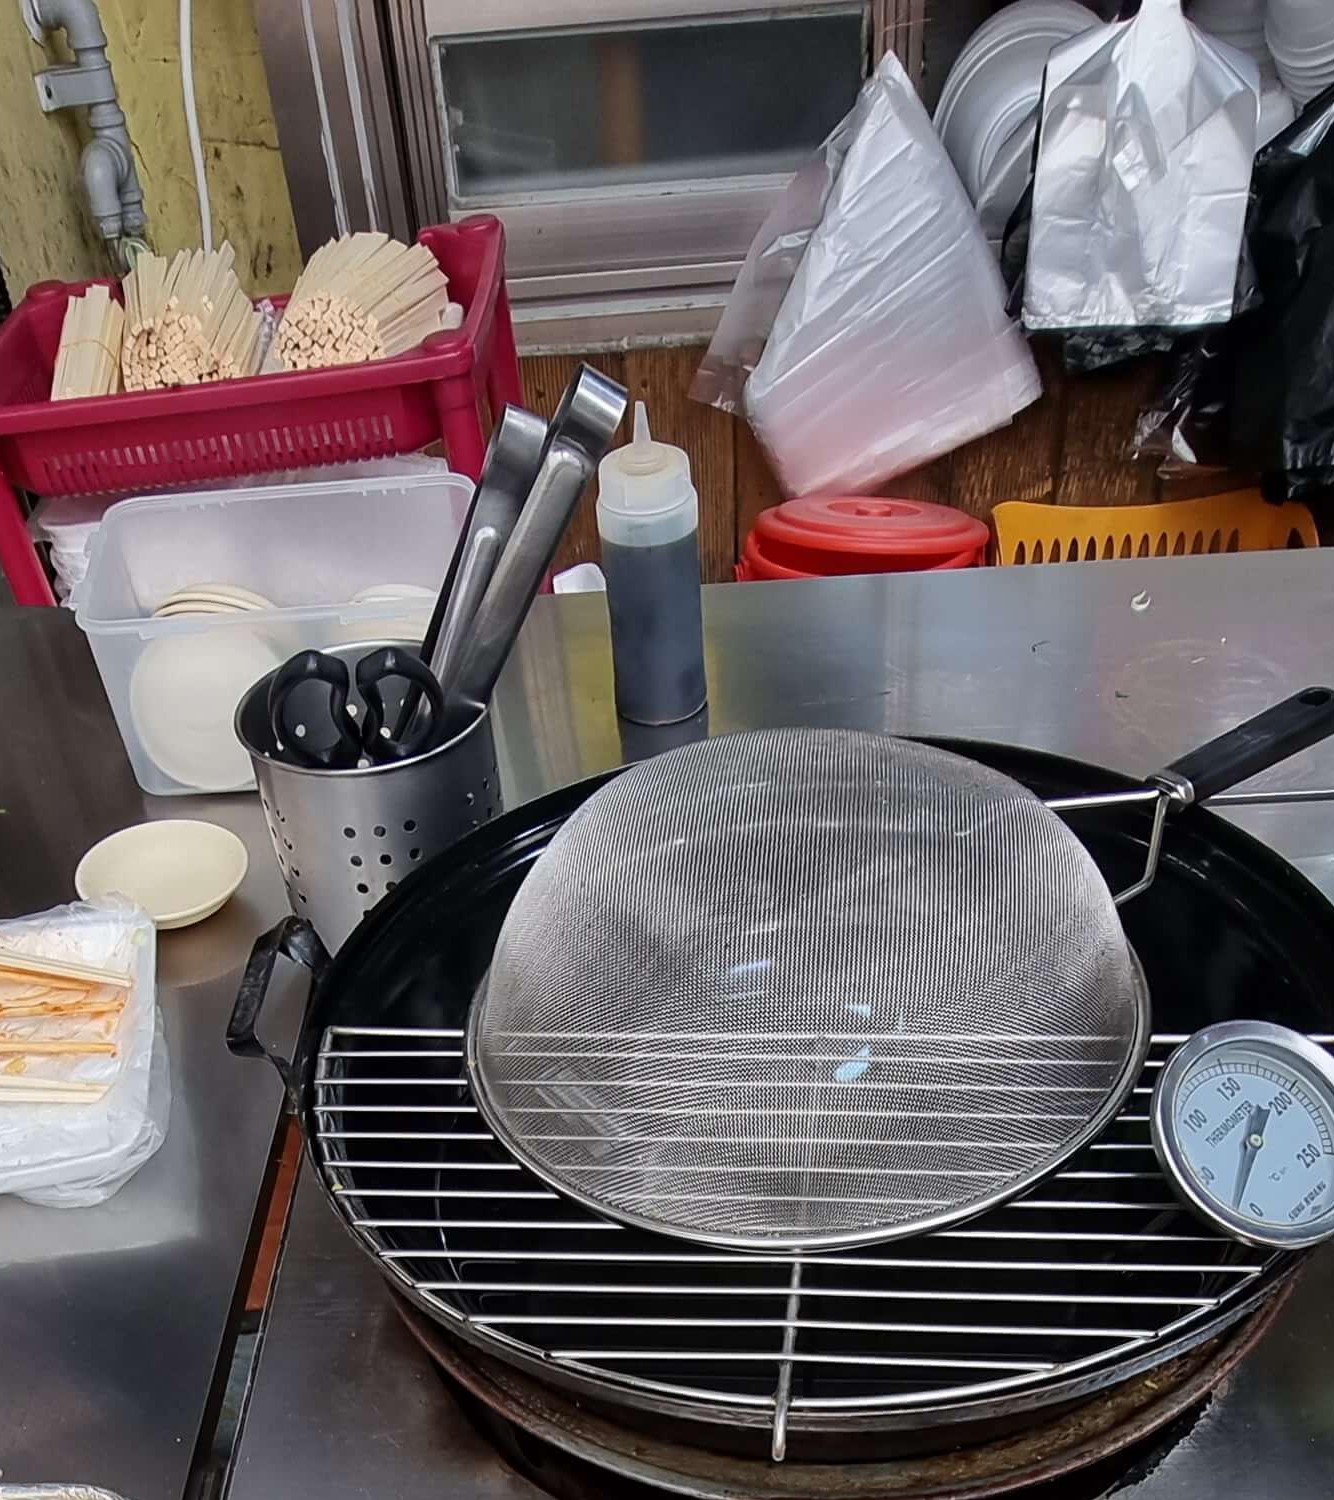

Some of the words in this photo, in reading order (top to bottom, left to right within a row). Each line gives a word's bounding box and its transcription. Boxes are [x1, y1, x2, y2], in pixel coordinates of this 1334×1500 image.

[1216, 1077, 1241, 1101] 150
[1269, 1091, 1292, 1116] 200
[1183, 1108, 1207, 1134] 100
[1296, 1143, 1321, 1169] 250
[1249, 1203, 1264, 1217] 0
